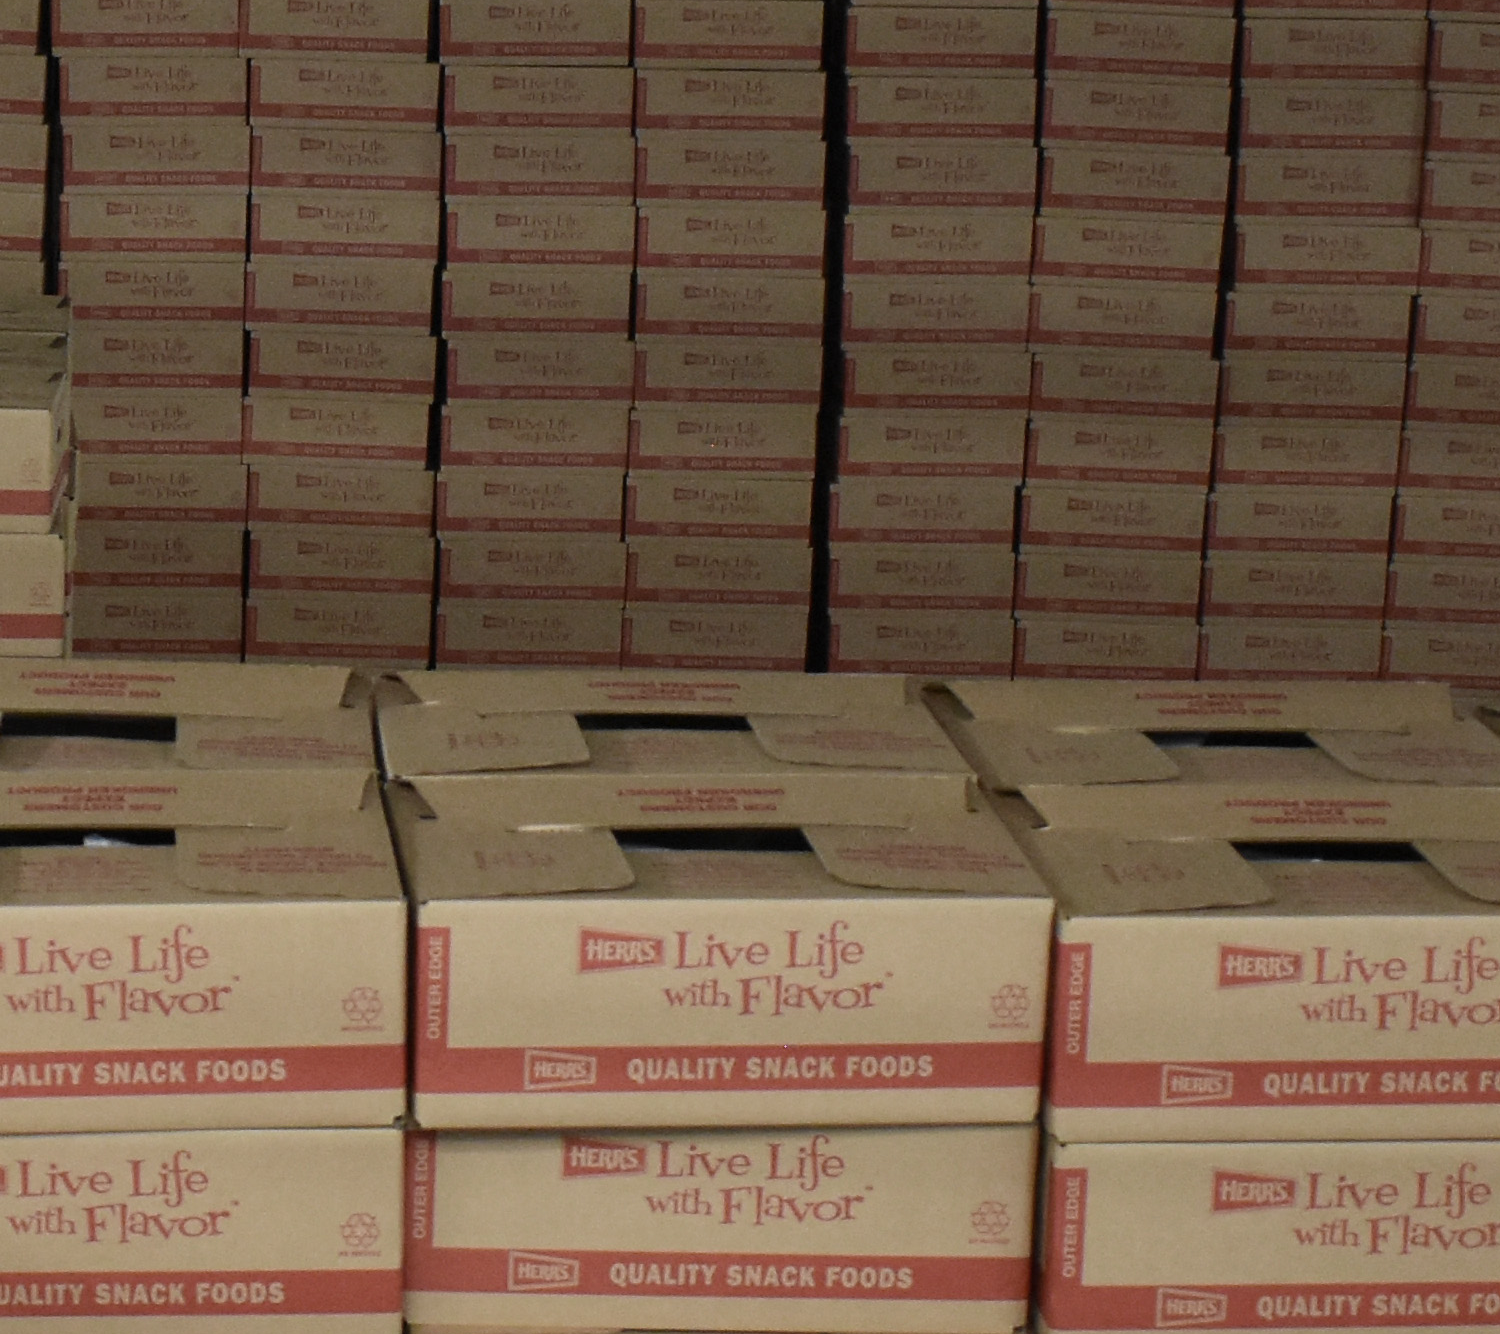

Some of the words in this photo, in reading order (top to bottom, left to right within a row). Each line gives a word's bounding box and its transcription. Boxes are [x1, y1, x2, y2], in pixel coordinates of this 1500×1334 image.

[429, 937, 443, 983] EDGE
[673, 931, 769, 970] Live
[785, 921, 864, 980] Life
[427, 986, 441, 1040] OUTER
[664, 981, 733, 1008] with
[737, 975, 884, 1016] Flavor
[627, 1055, 733, 1081] QUALITY
[745, 1056, 836, 1078] SNACK
[845, 1054, 933, 1078] FOODS
